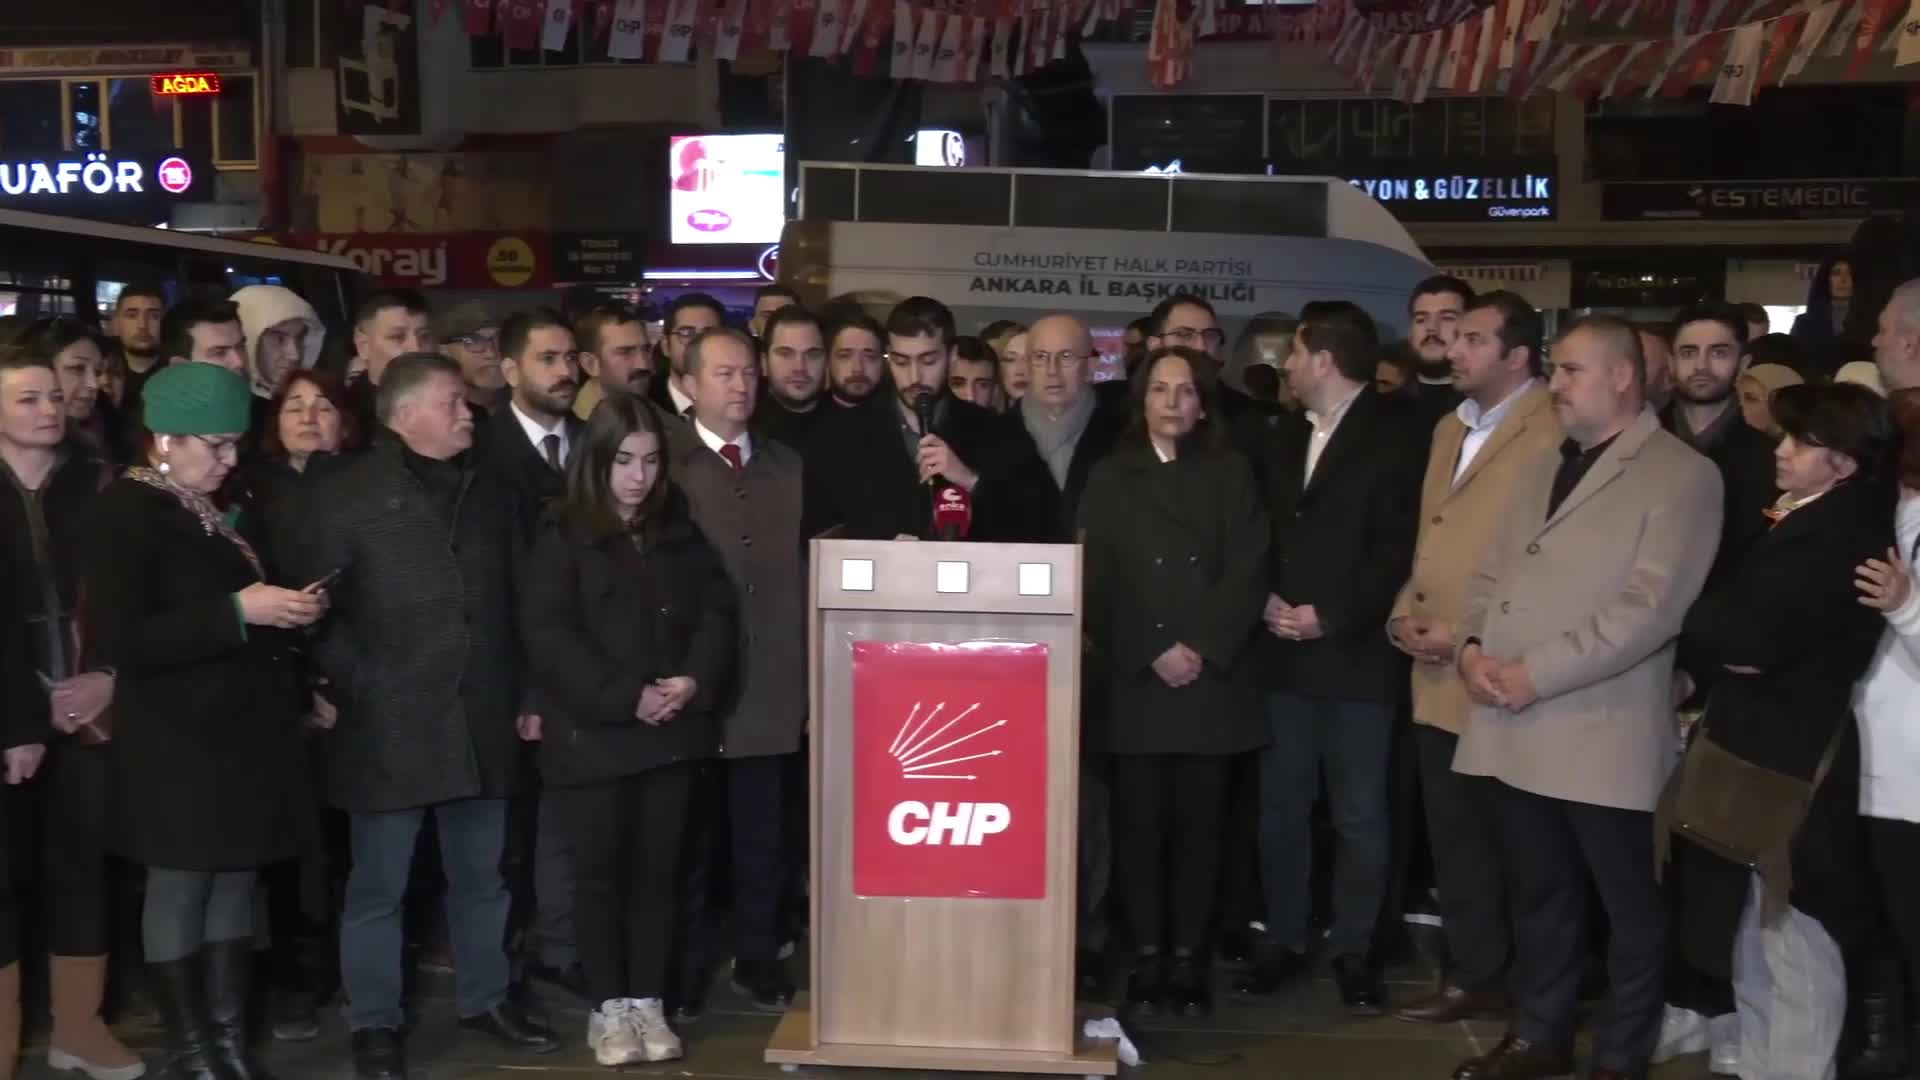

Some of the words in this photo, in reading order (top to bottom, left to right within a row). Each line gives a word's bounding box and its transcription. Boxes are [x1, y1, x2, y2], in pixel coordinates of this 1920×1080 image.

[162, 74, 209, 92] AĞDA
[0, 153, 144, 195] UAFÖR
[1414, 178, 1430, 200] &
[1434, 175, 1550, 200] GÜZELLİK
[974, 251, 1108, 272] CUMHURİYET
[1114, 257, 1168, 274] HALK
[969, 276, 1072, 297] ANKARA
[1079, 275, 1102, 296] İL
[1108, 279, 1256, 303] BAŞKANLIĞI
[888, 801, 1011, 846] CHP
